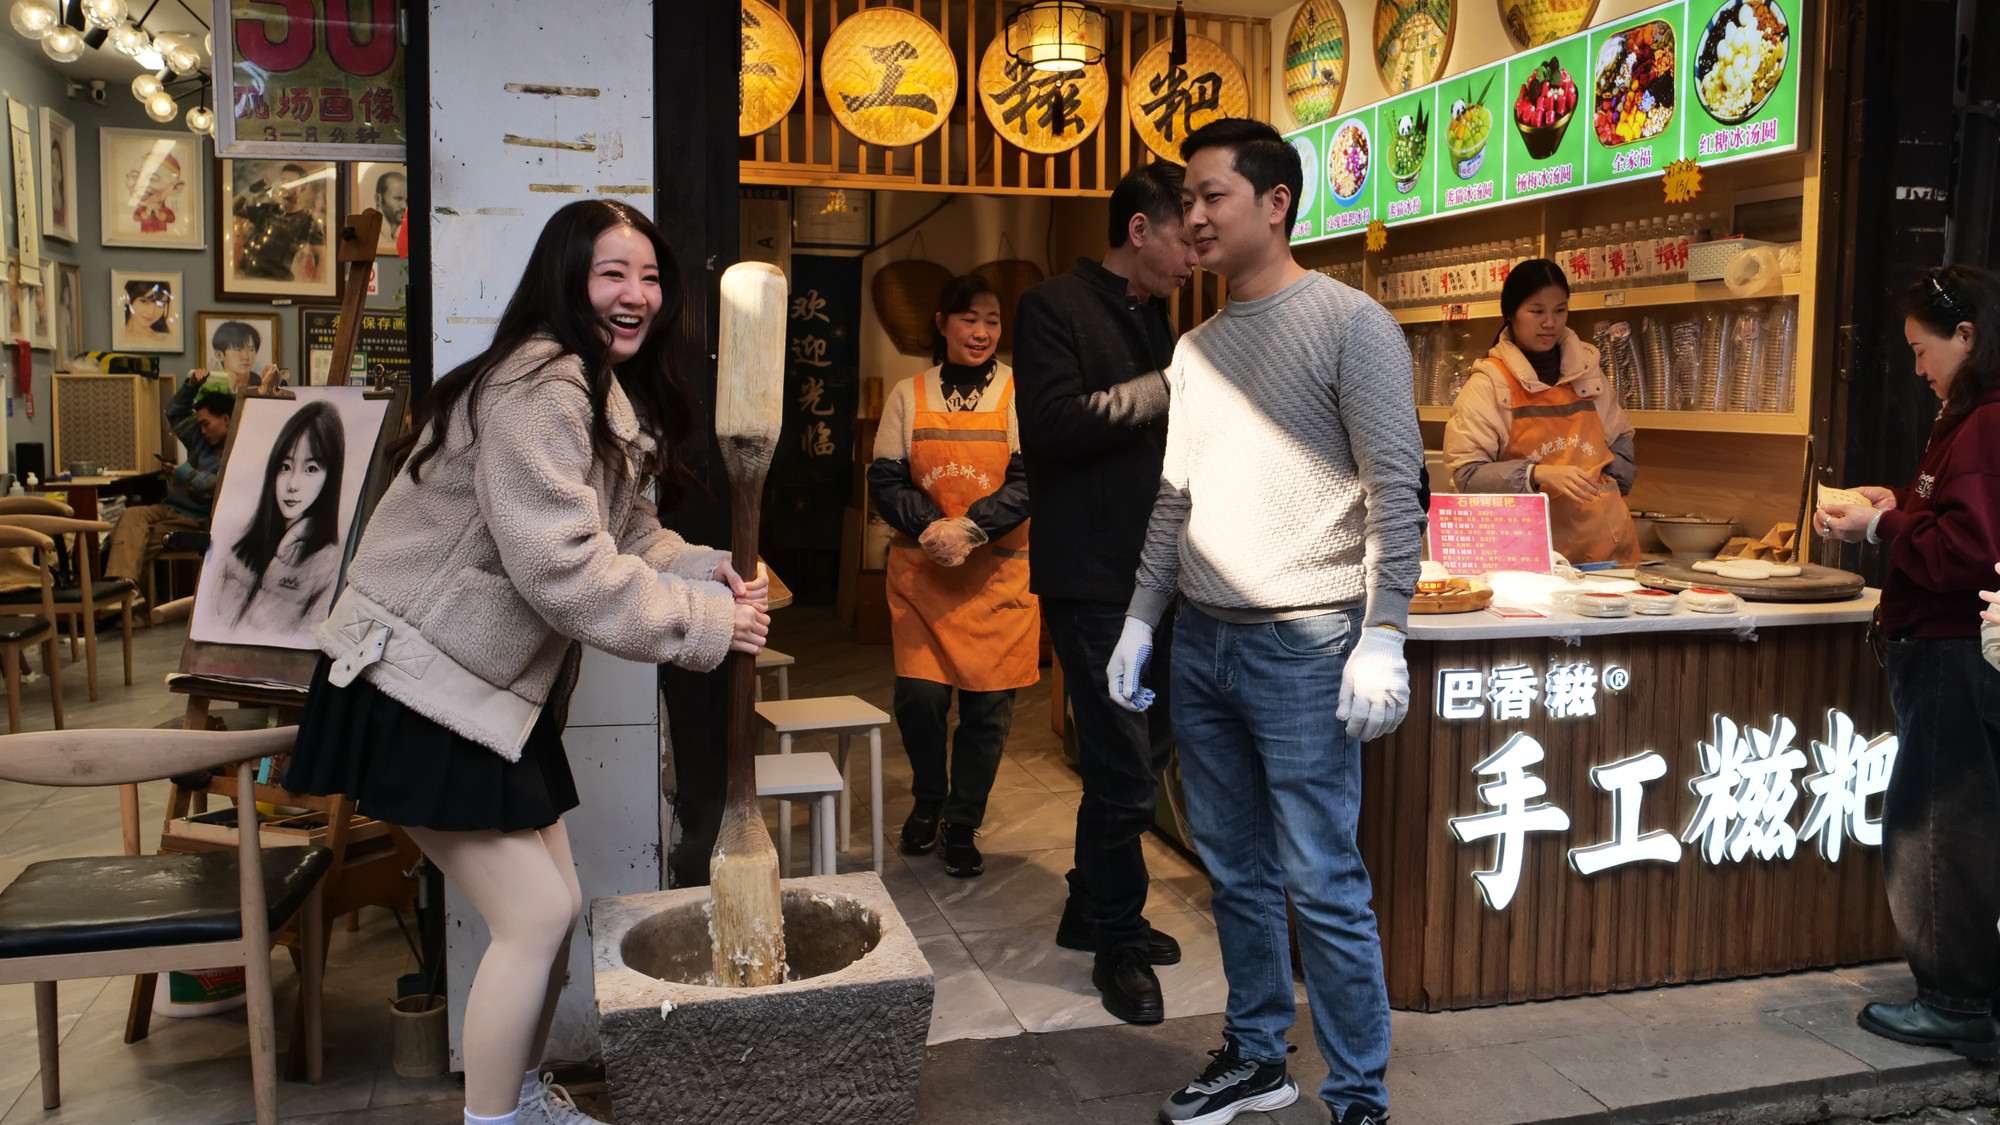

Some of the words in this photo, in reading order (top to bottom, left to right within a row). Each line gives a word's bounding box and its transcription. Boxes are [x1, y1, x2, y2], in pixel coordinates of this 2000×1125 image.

[1698, 118, 1778, 156] 红糖冰汤圆
[1612, 146, 1652, 174] 全家福
[1445, 180, 1493, 208] 熊猫冰汤圆
[1516, 163, 1573, 193] 杨梅冰汤圆
[790, 288, 836, 458] 欢迎光临
[1448, 707, 1899, 911] 手工糍粑
